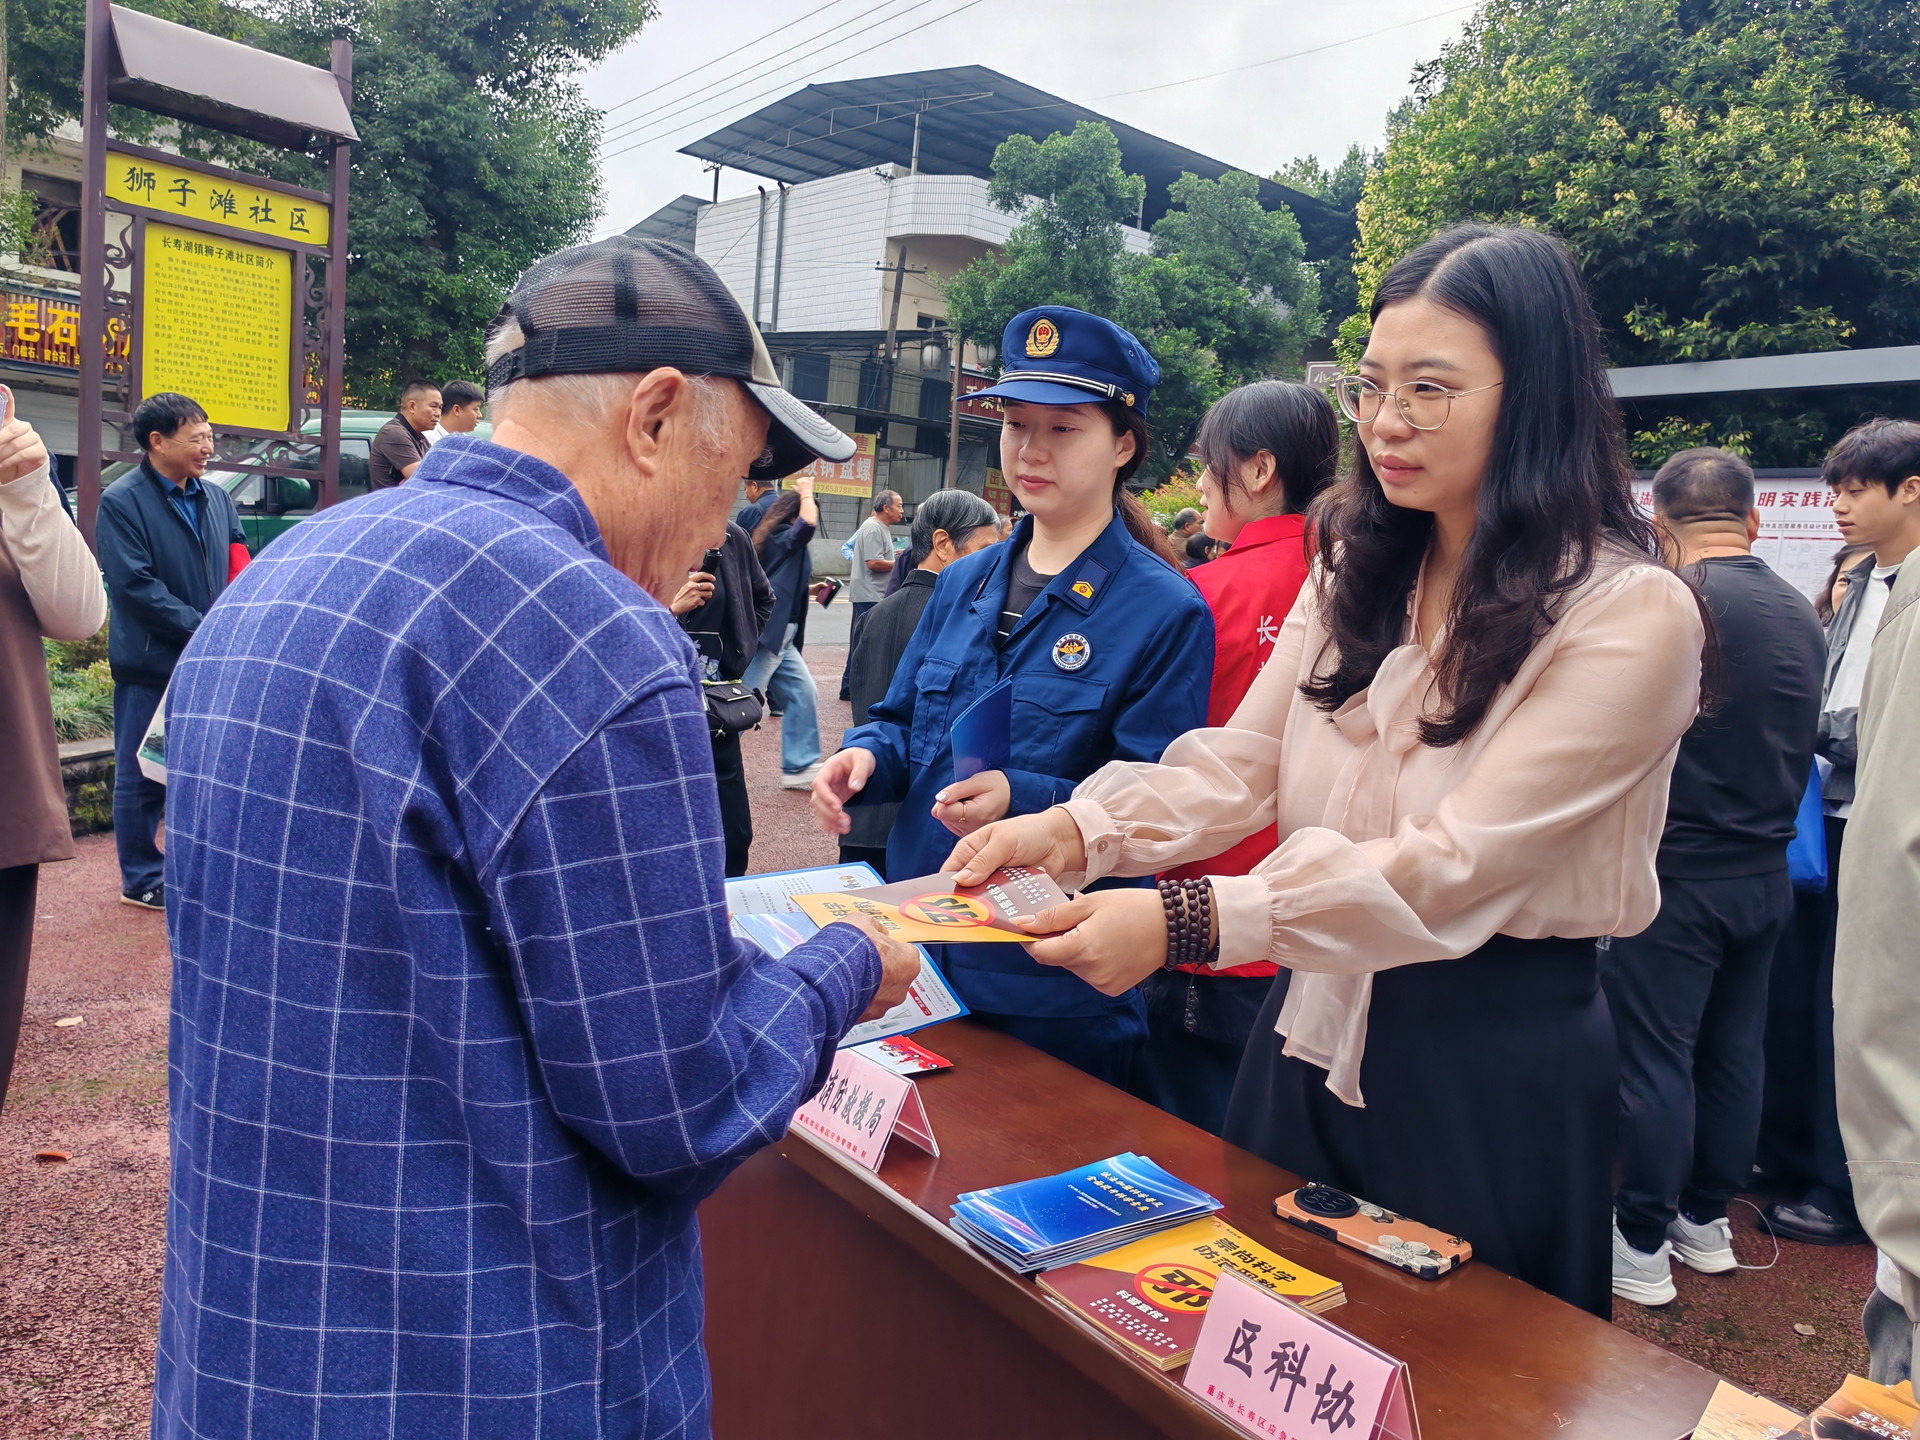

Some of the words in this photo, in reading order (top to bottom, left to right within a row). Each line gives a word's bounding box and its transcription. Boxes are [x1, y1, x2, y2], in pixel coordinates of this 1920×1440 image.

[123, 166, 310, 234] 狮子滩社区
[162, 235, 274, 270] 长寿湖镇狮子滩社区简介
[5, 303, 80, 347] 毛石
[793, 457, 872, 481] 纹钢盘螺
[1257, 615, 1285, 646] 长
[813, 1069, 886, 1139] 消防救援局
[1213, 1238, 1297, 1282] 崇尚科学
[1223, 1318, 1356, 1434] 区科协
[1206, 1384, 1299, 1440] 重庆市长寿区应急
